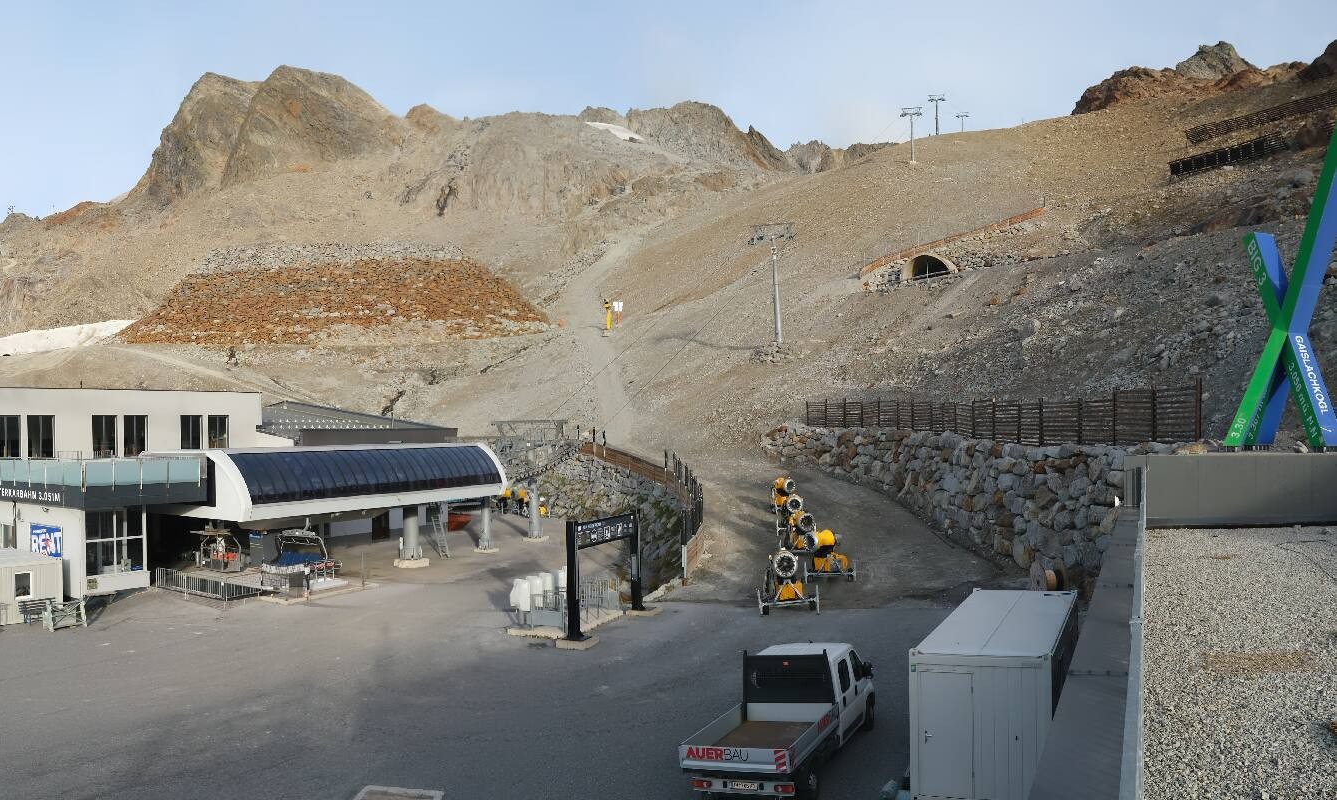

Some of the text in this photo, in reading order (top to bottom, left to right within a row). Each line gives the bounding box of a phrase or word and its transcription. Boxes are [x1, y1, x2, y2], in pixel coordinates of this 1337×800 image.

[1247, 239, 1267, 285] BIG 3
[1295, 335, 1329, 415] GAISLACHKOGL
[31, 532, 62, 554] RENT
